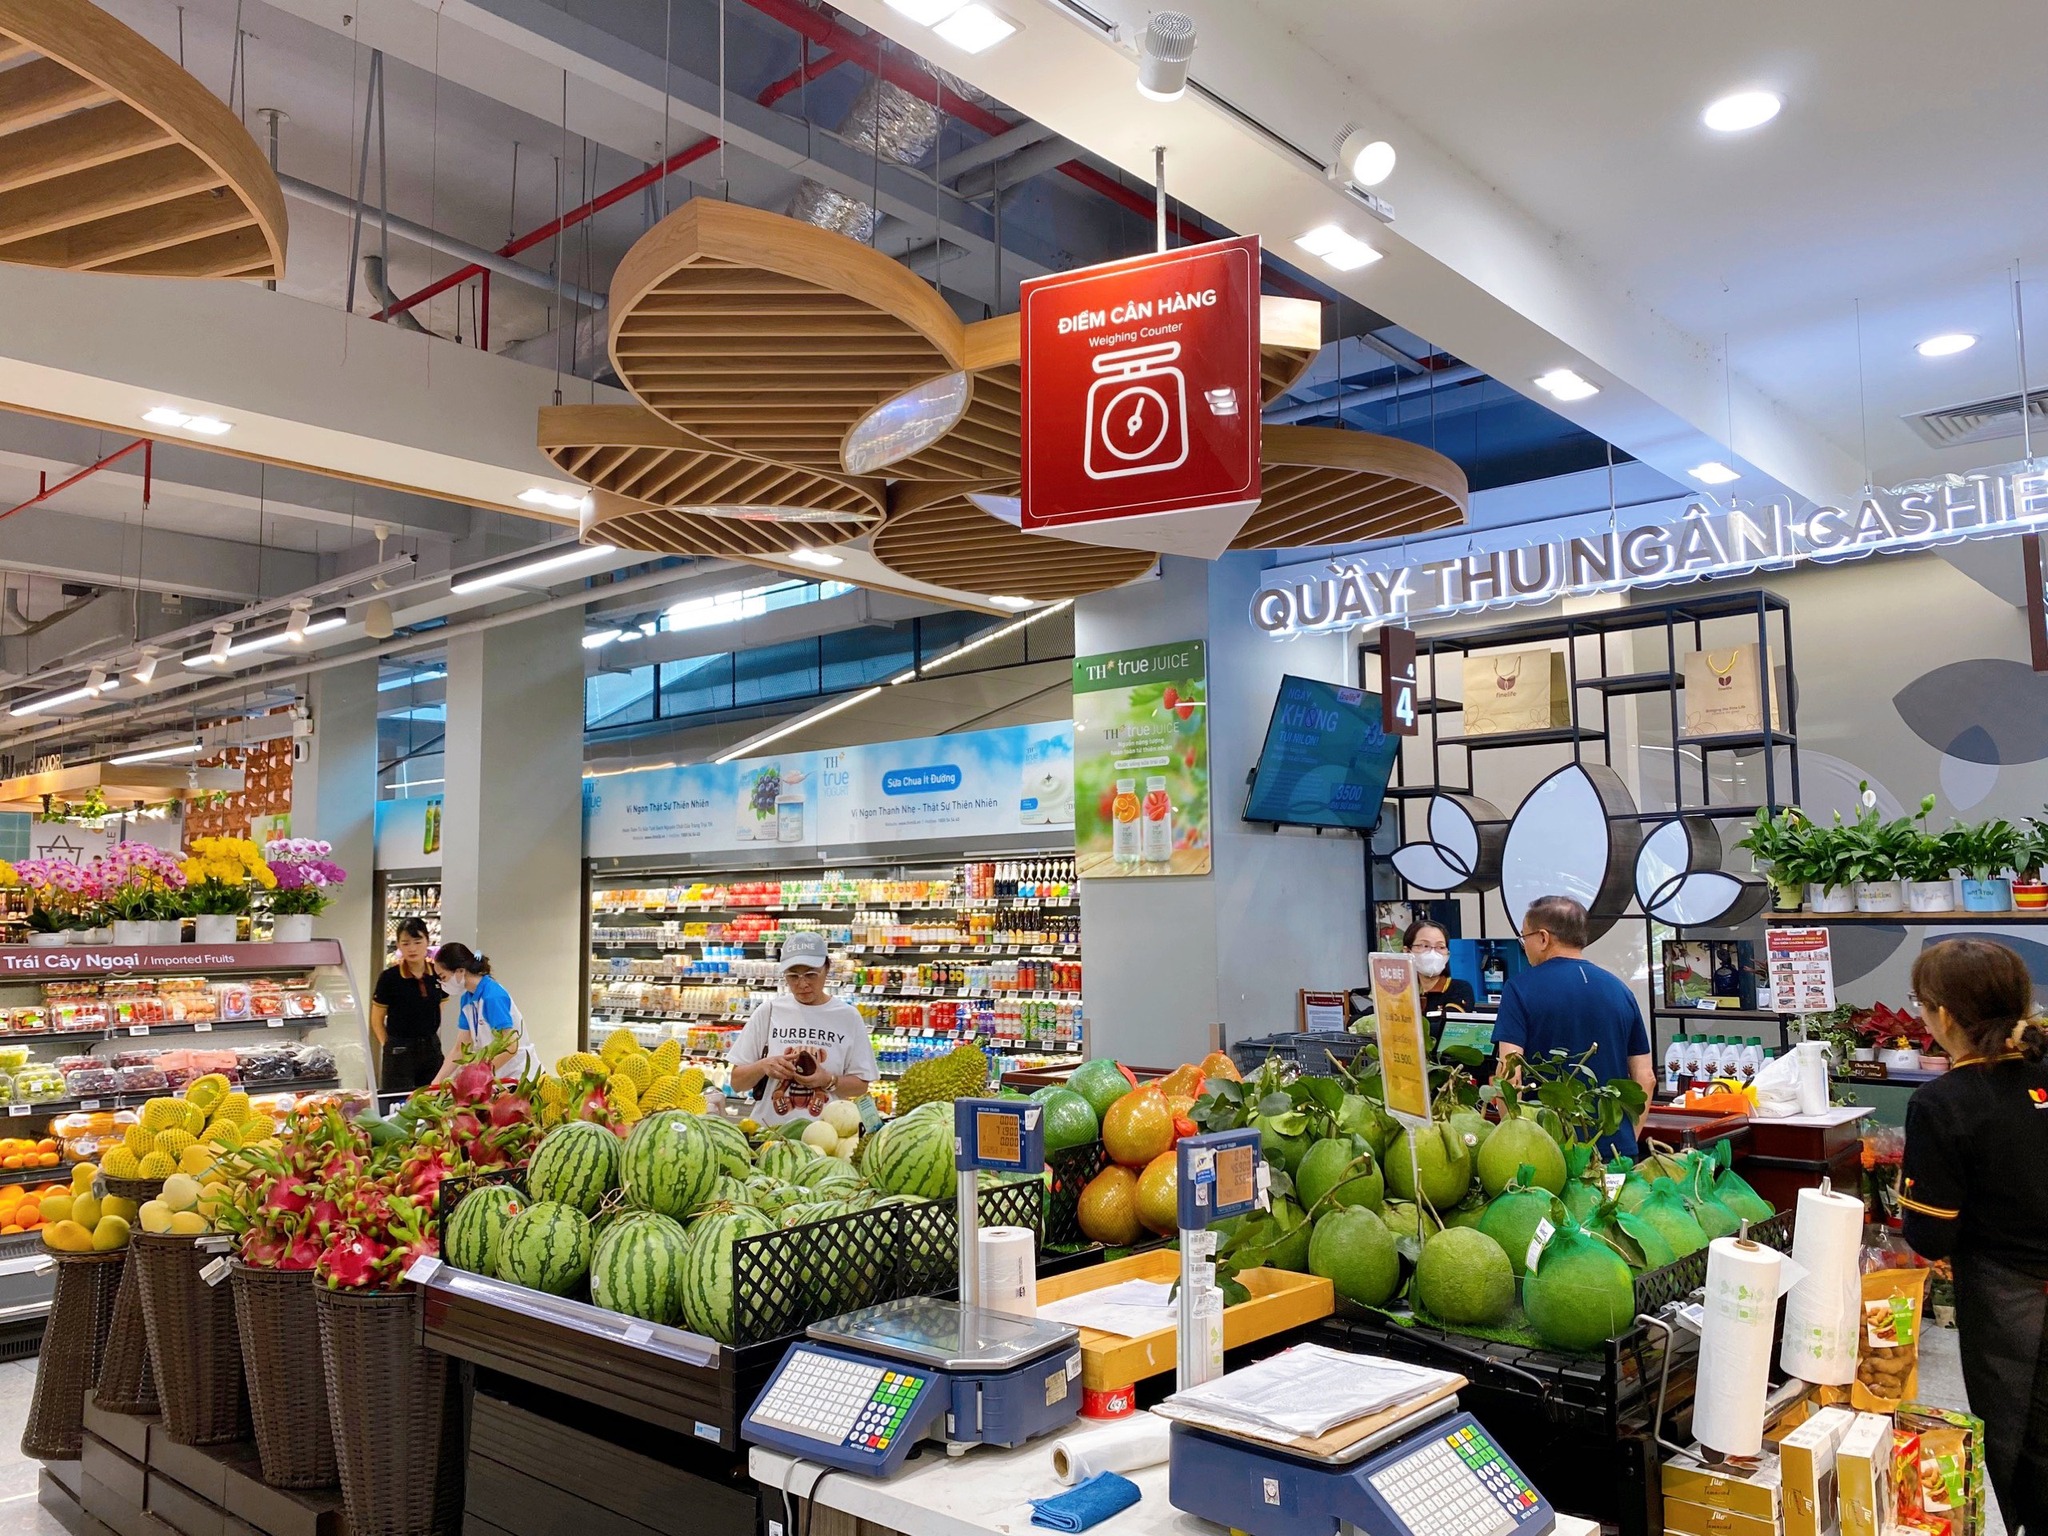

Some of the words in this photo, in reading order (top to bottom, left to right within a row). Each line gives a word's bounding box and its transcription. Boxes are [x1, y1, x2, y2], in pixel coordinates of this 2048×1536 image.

[1058, 309, 1106, 335] ĐIỂM
[1110, 300, 1153, 324] CÂN
[1158, 289, 1217, 316] HÀNG
[1088, 332, 1138, 348] Weighing
[1140, 323, 1183, 338] Counter
[1252, 562, 1410, 634] QUẦY
[1422, 541, 1558, 609] THU
[1570, 502, 1785, 588] NGÂN
[1086, 665, 1107, 681] TH
[1117, 658, 1149, 676] true
[1152, 652, 1190, 672] JUICE
[1407, 663, 1414, 678] 4
[1495, 690, 1517, 698] finelife
[1396, 687, 1415, 727] 4
[1281, 702, 1340, 733] KHÔNG
[1103, 728, 1119, 740] TH
[1127, 724, 1150, 738] true
[1151, 721, 1180, 735] JUICE
[823, 755, 839, 768] TH
[823, 769, 850, 786] true
[887, 775, 902, 788] Sữa
[902, 774, 922, 787] Chua
[930, 771, 956, 786] Đường
[1336, 783, 1363, 801] 3500
[632, 804, 648, 815] Ngon
[649, 802, 663, 813] Thật
[673, 800, 689, 811] Thiên
[690, 799, 709, 809] Nhiên
[859, 807, 877, 820] Ngon
[878, 805, 900, 816] Thanh
[901, 804, 916, 815] Nhẹ
[923, 802, 939, 813] Thật
[940, 801, 951, 812] Sự
[952, 799, 974, 810] Thiên
[974, 797, 998, 808] Nhiên
[3, 954, 40, 969] Trái
[44, 955, 81, 971] Cây
[86, 953, 140, 970] Ngoại
[150, 955, 202, 968] Imported
[204, 953, 235, 964] Fruits
[772, 1027, 845, 1044] BURBERRY
[806, 1039, 832, 1048] ENGLAND
